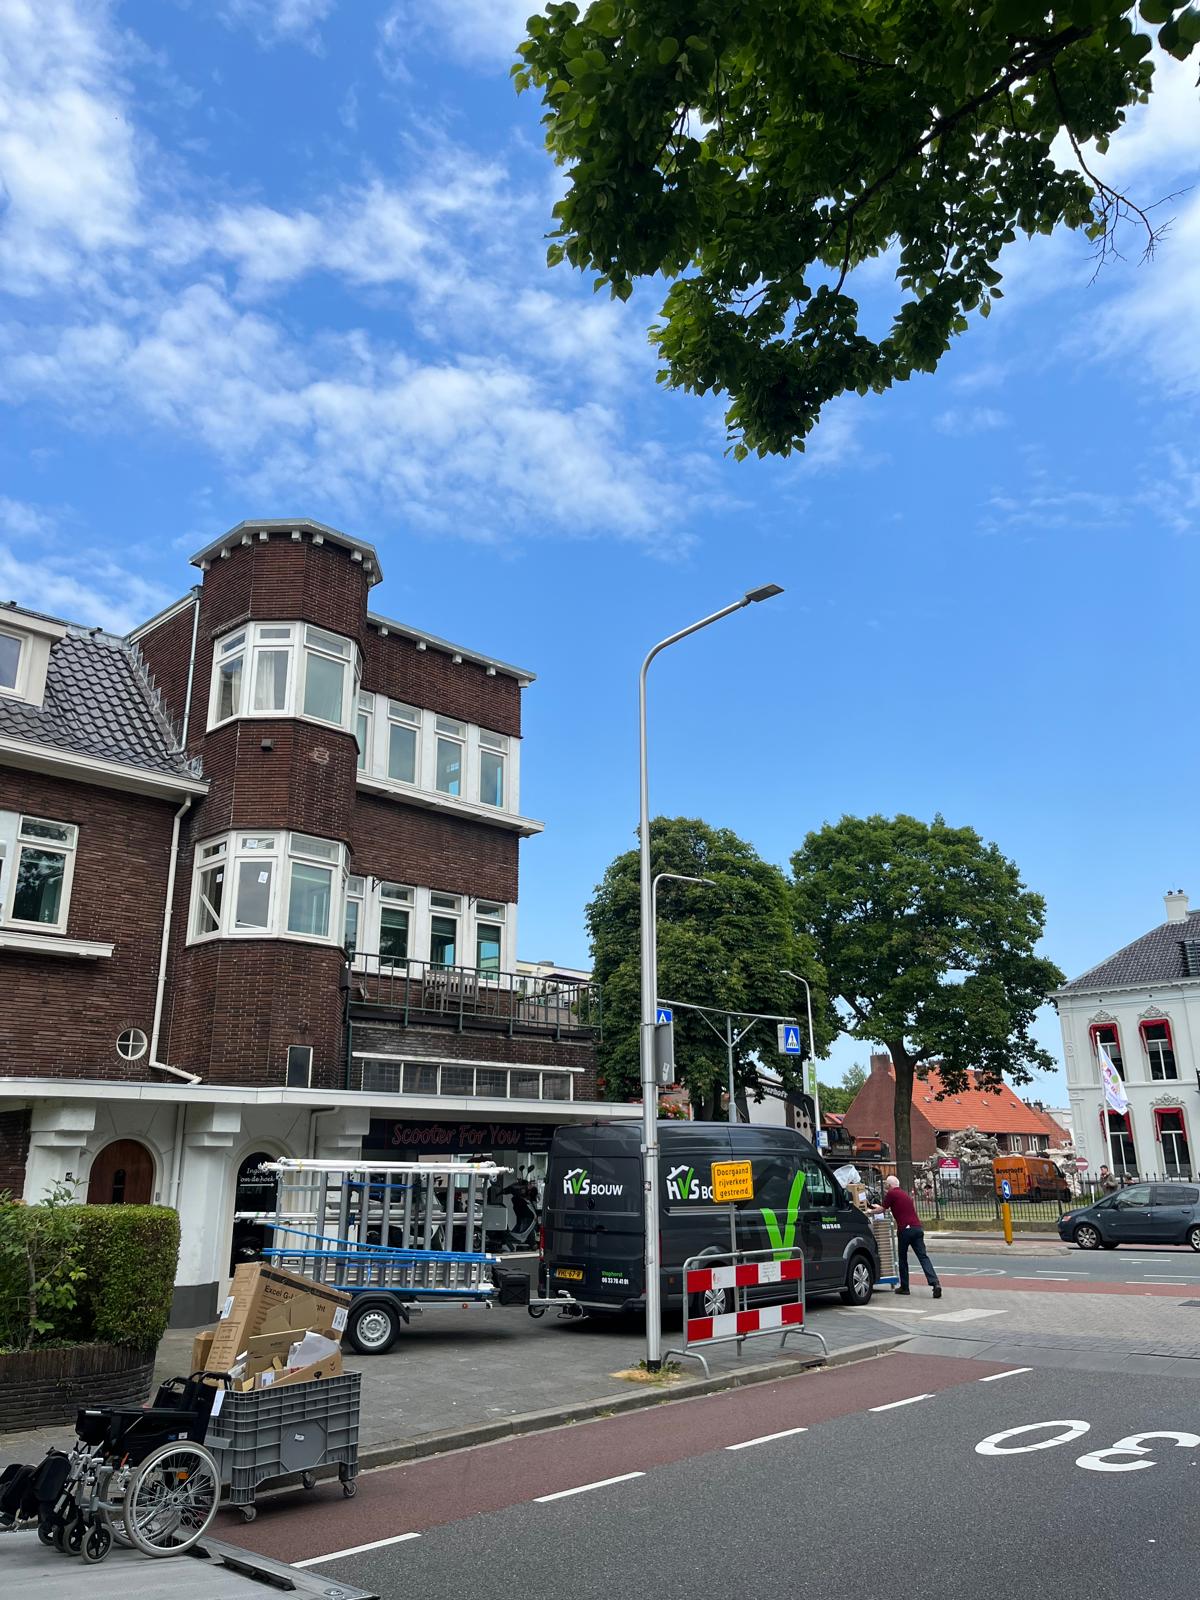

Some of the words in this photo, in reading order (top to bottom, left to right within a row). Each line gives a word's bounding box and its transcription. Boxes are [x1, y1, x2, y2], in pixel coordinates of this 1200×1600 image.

[392, 1124, 456, 1145] Scooter
[458, 1125, 488, 1148] For
[489, 1125, 521, 1145] You
[716, 1167, 749, 1177] Doorgaand
[563, 1170, 590, 1195] HVS
[591, 1184, 623, 1196] BOUW
[666, 1167, 700, 1200] HVS
[719, 1178, 748, 1188] rijverkeer
[264, 1285, 282, 1298] Excel
